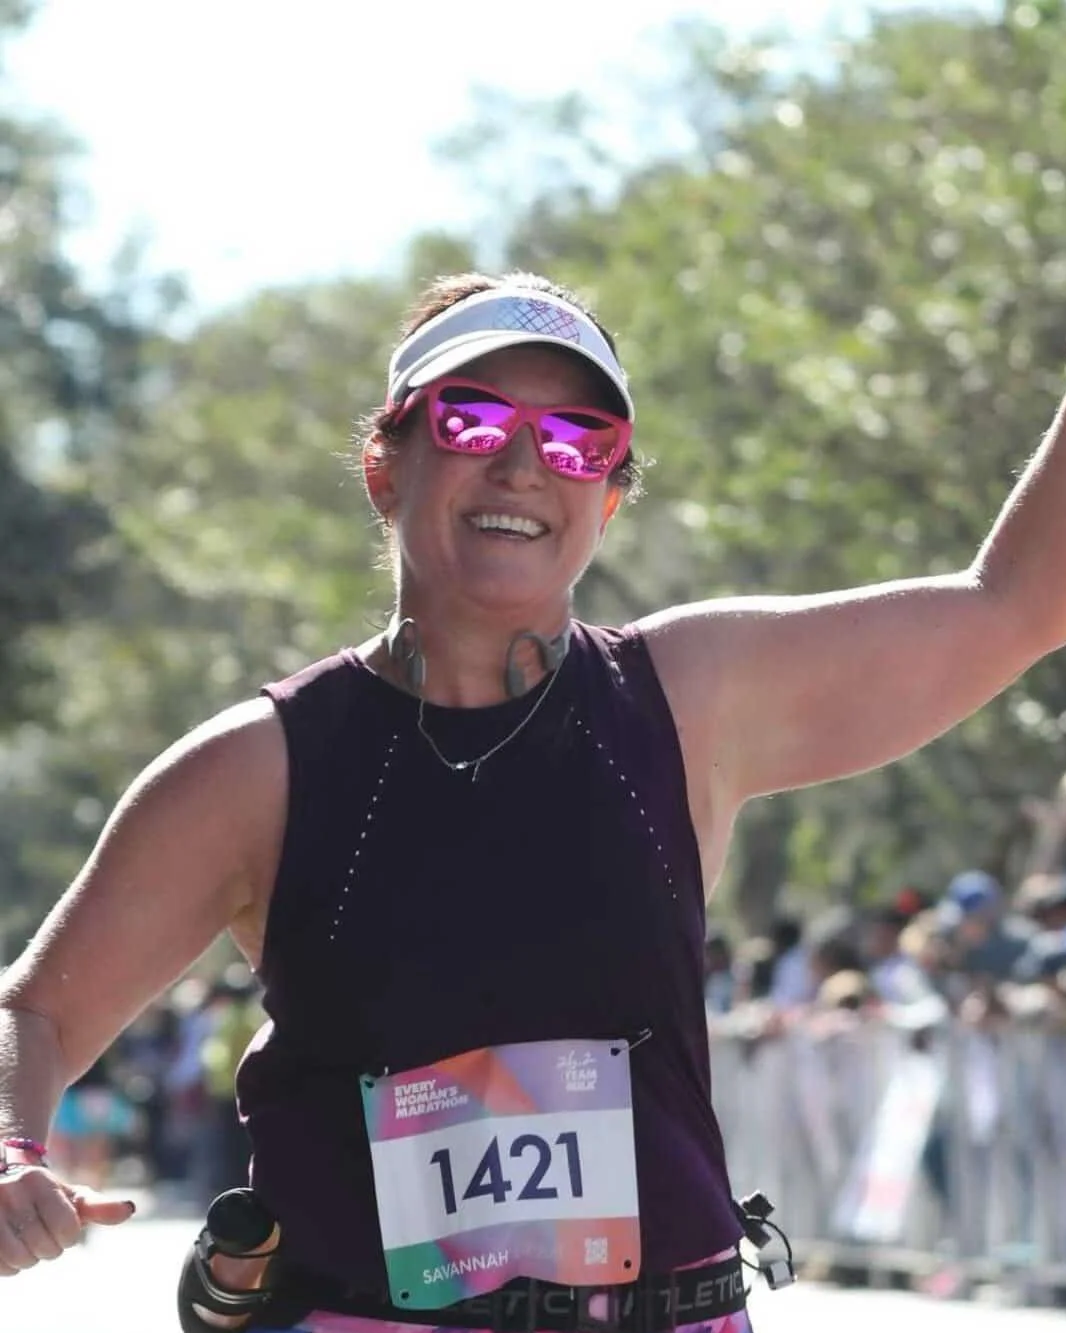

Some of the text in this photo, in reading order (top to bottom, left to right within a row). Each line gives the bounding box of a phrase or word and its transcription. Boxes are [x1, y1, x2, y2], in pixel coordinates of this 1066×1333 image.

[564, 1069, 598, 1081] TEAM
[394, 1079, 436, 1098] EVERY
[395, 1086, 458, 1107] WOMAN'S
[395, 1094, 468, 1119] MARATHON
[430, 1131, 583, 1215] 1421
[423, 1249, 509, 1285] SAVANNAH
